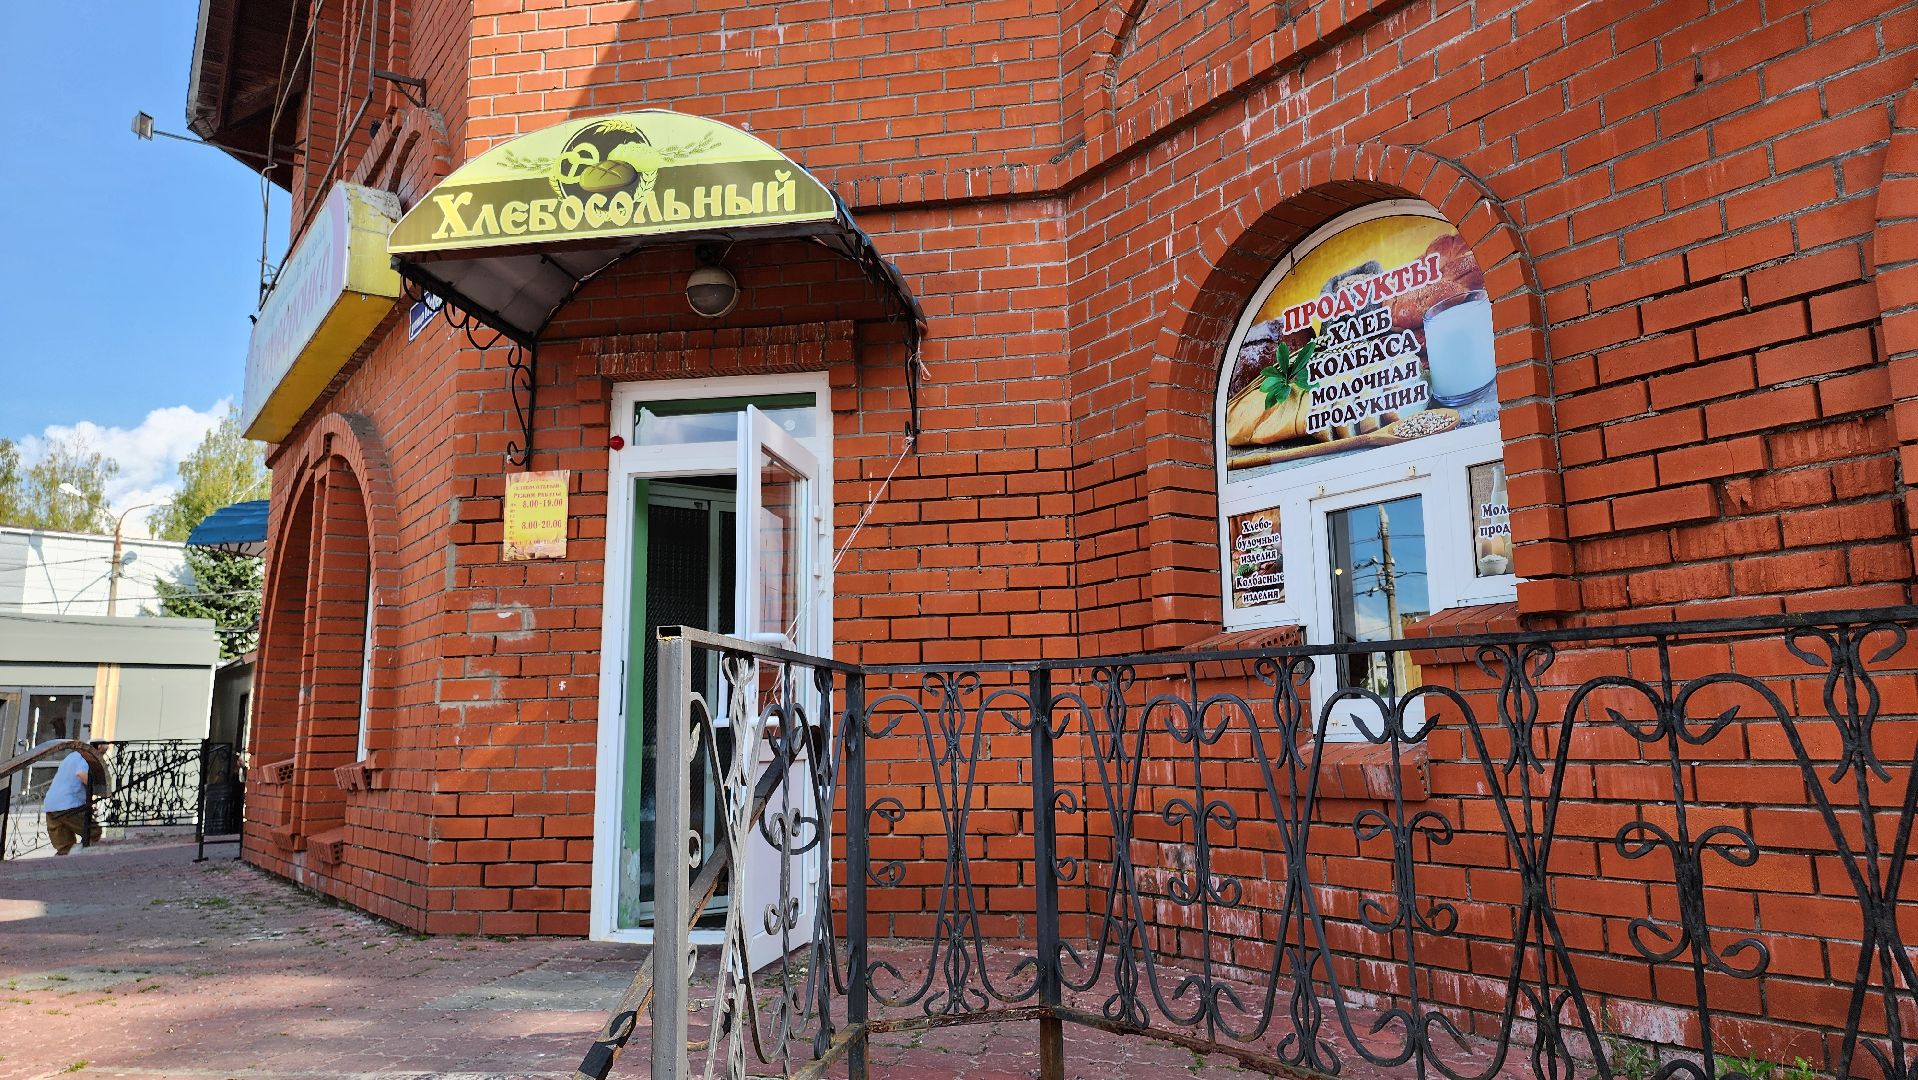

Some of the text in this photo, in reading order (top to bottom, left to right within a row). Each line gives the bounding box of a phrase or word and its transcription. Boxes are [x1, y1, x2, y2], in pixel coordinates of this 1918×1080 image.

[1283, 255, 1441, 333] ПРОДУКТЫ
[1330, 309, 1391, 346] ХЛЕБ
[1309, 332, 1419, 382] КОЛБАСА
[1312, 361, 1418, 407] МОЛОЧНАЯ
[1307, 384, 1428, 432] ПРОДУКЦИЯ
[1482, 503, 1510, 518] Мол
[1243, 517, 1272, 533] Хлебо-
[1237, 534, 1280, 550] булочные
[1241, 550, 1277, 564] изделия
[1236, 571, 1285, 588] Колбасные
[1243, 589, 1279, 602] изделия
